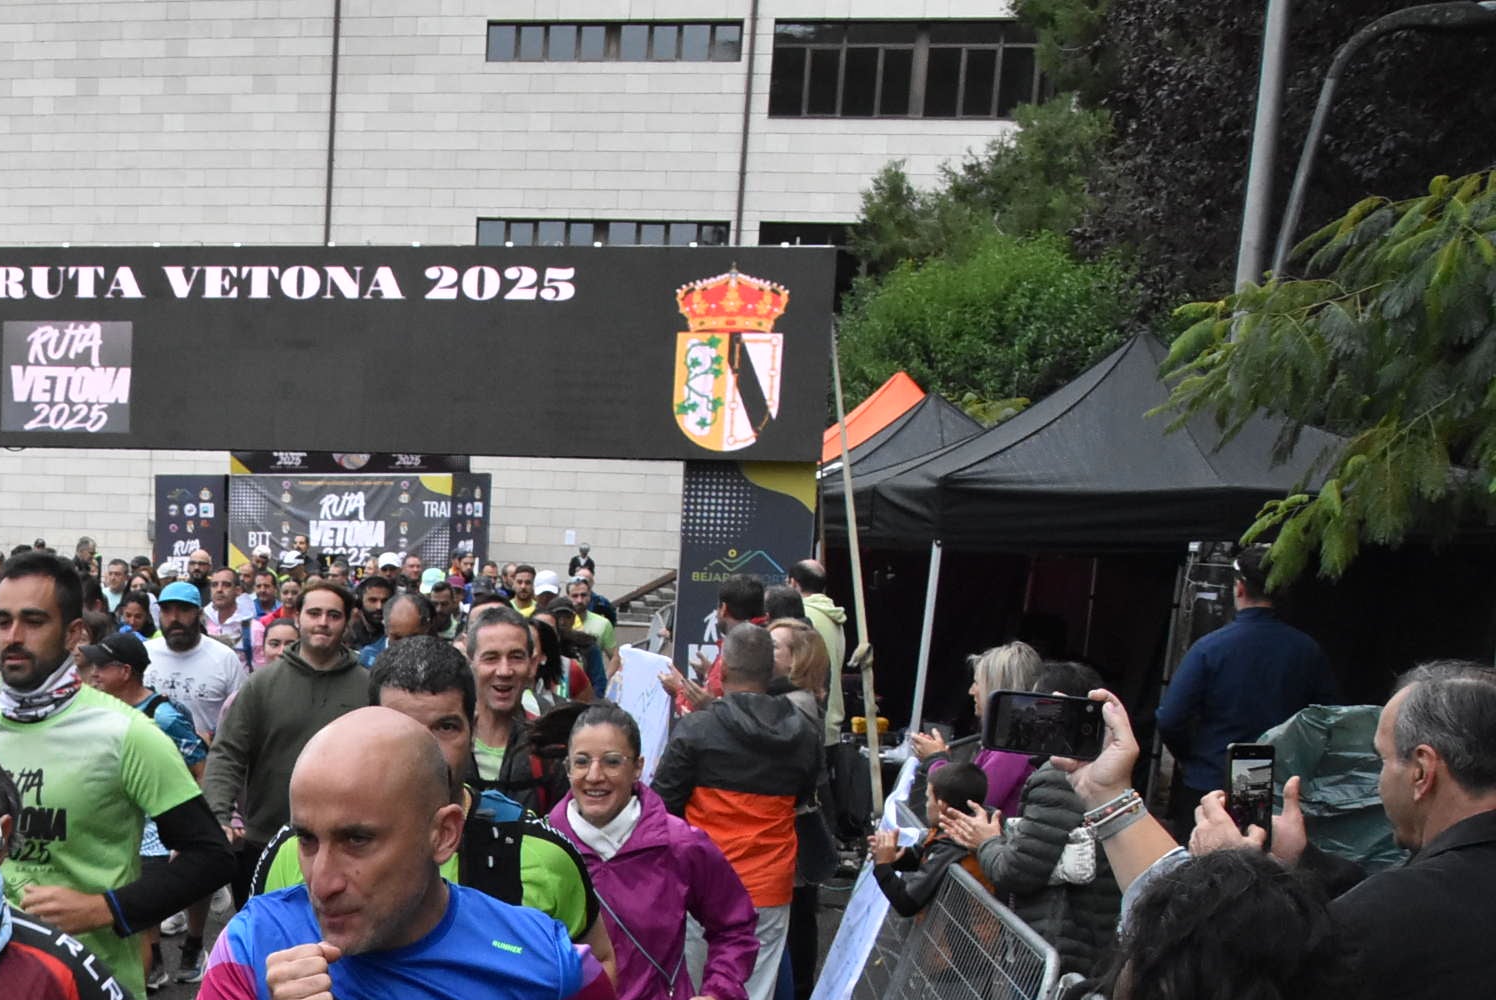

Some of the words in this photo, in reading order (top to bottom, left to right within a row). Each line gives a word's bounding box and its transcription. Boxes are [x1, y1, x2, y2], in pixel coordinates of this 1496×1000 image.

[162, 265, 406, 299] VETONA
[424, 265, 575, 301] 2025
[26, 322, 103, 367] RUTA
[10, 364, 132, 404] VETONA
[23, 403, 109, 432] 2025
[320, 491, 366, 520] RUTA
[422, 501, 451, 518] TRAI
[309, 520, 385, 547] VETONA
